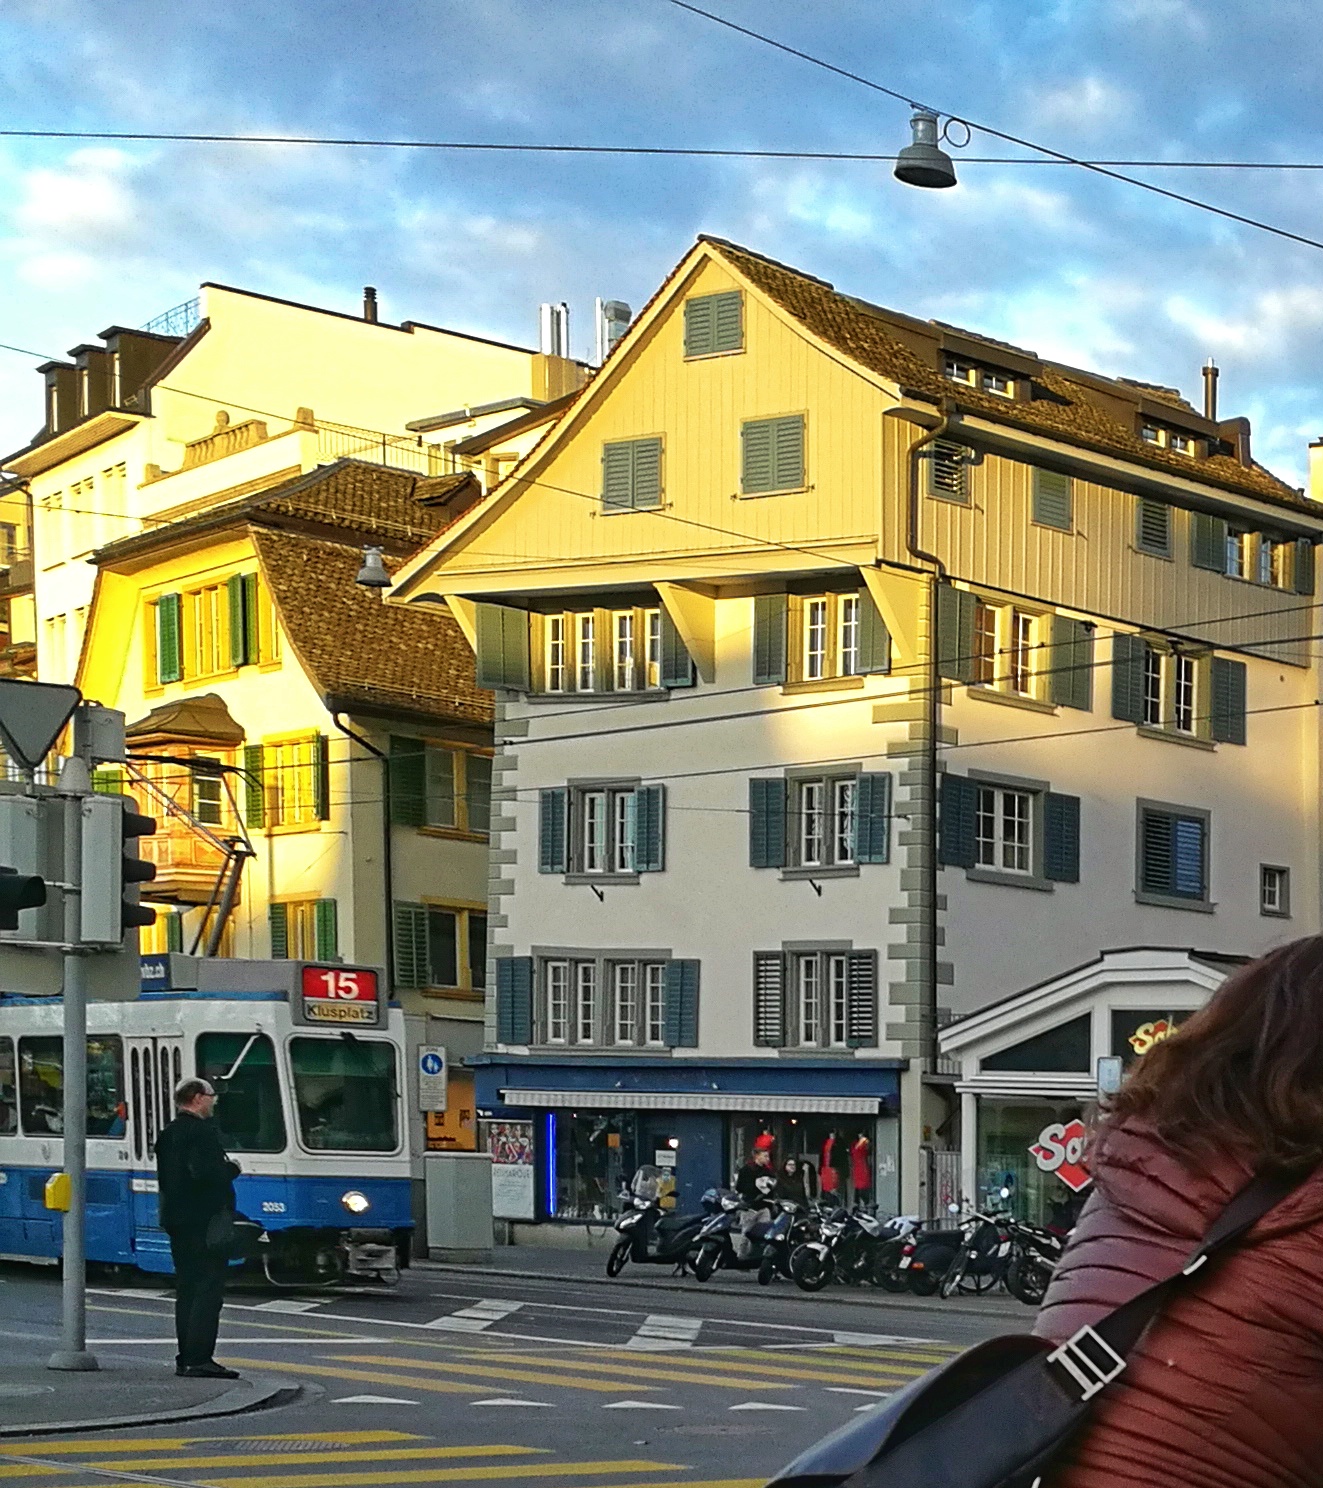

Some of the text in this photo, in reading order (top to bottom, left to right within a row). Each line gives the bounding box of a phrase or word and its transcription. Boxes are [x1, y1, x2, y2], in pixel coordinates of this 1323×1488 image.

[321, 972, 360, 1000] 15
[307, 1003, 374, 1021] Klusplatz
[262, 1202, 286, 1213] 2053
